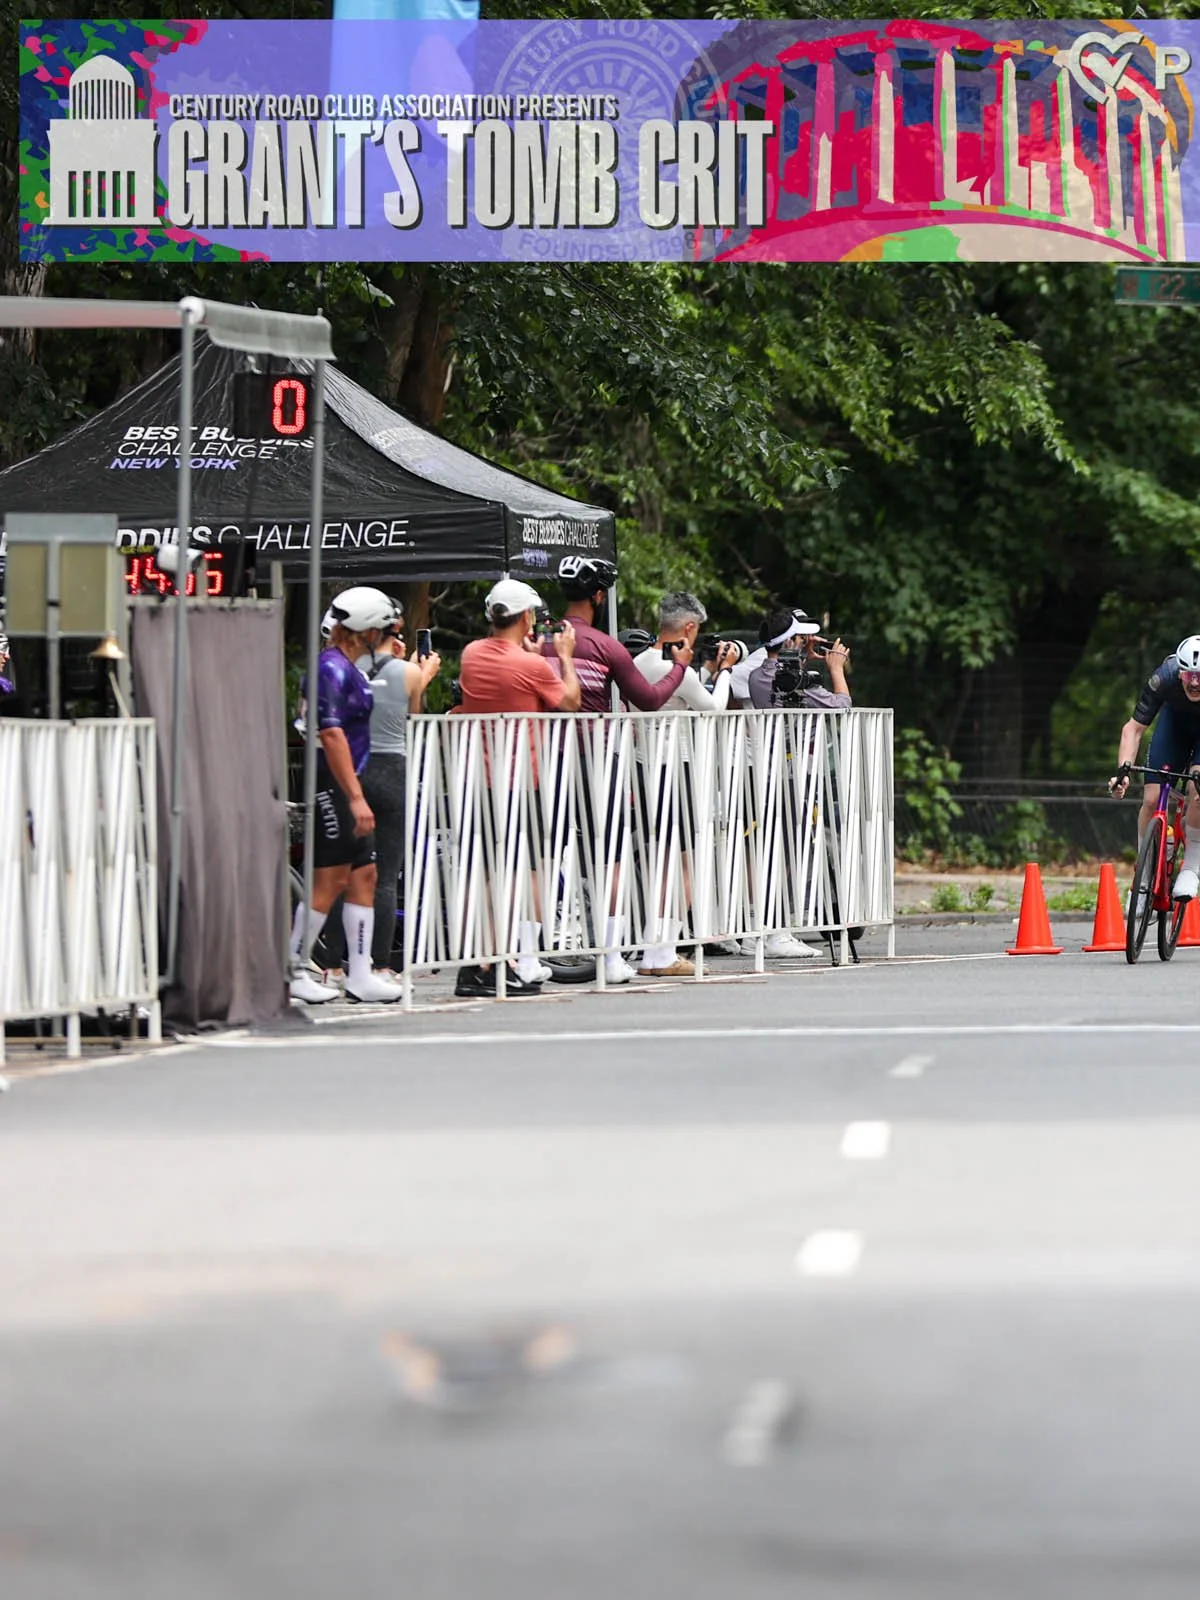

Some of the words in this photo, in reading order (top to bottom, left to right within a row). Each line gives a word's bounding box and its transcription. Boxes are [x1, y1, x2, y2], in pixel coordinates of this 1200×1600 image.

[272, 379, 307, 435] 0
[123, 425, 199, 440] BES
[109, 457, 169, 469] NEW
